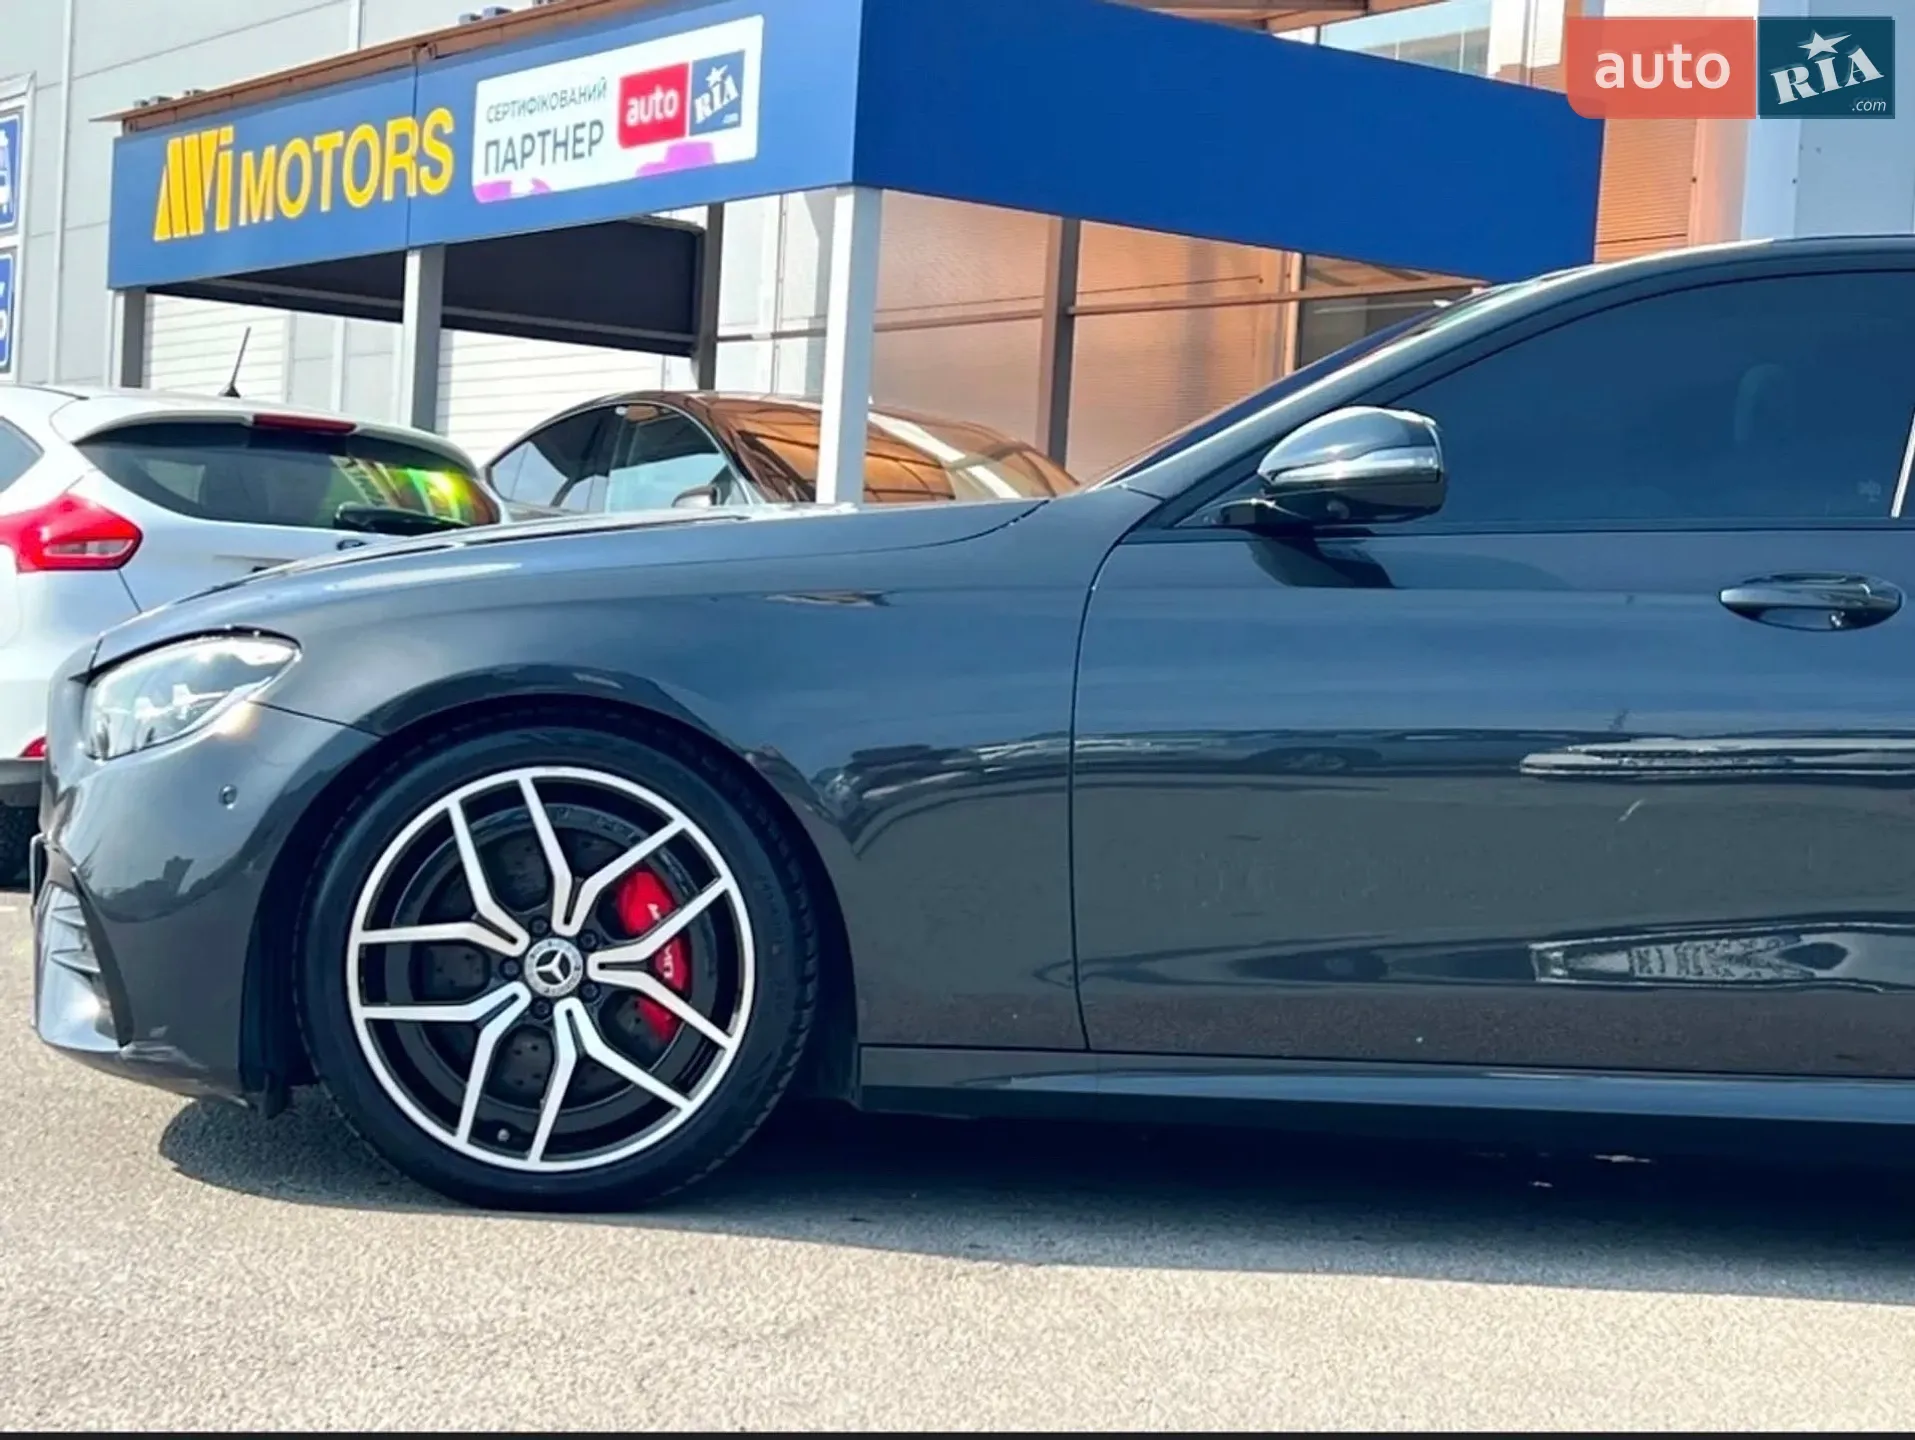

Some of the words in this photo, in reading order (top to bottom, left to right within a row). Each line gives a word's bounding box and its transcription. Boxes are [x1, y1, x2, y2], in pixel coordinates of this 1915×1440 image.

[485, 76, 608, 125] СЕРТИФІКОВАНИЙ
[625, 85, 680, 128] auto
[694, 72, 740, 124] RIA
[239, 106, 454, 227] MOTORS
[483, 118, 604, 176] ПАРТНЕР
